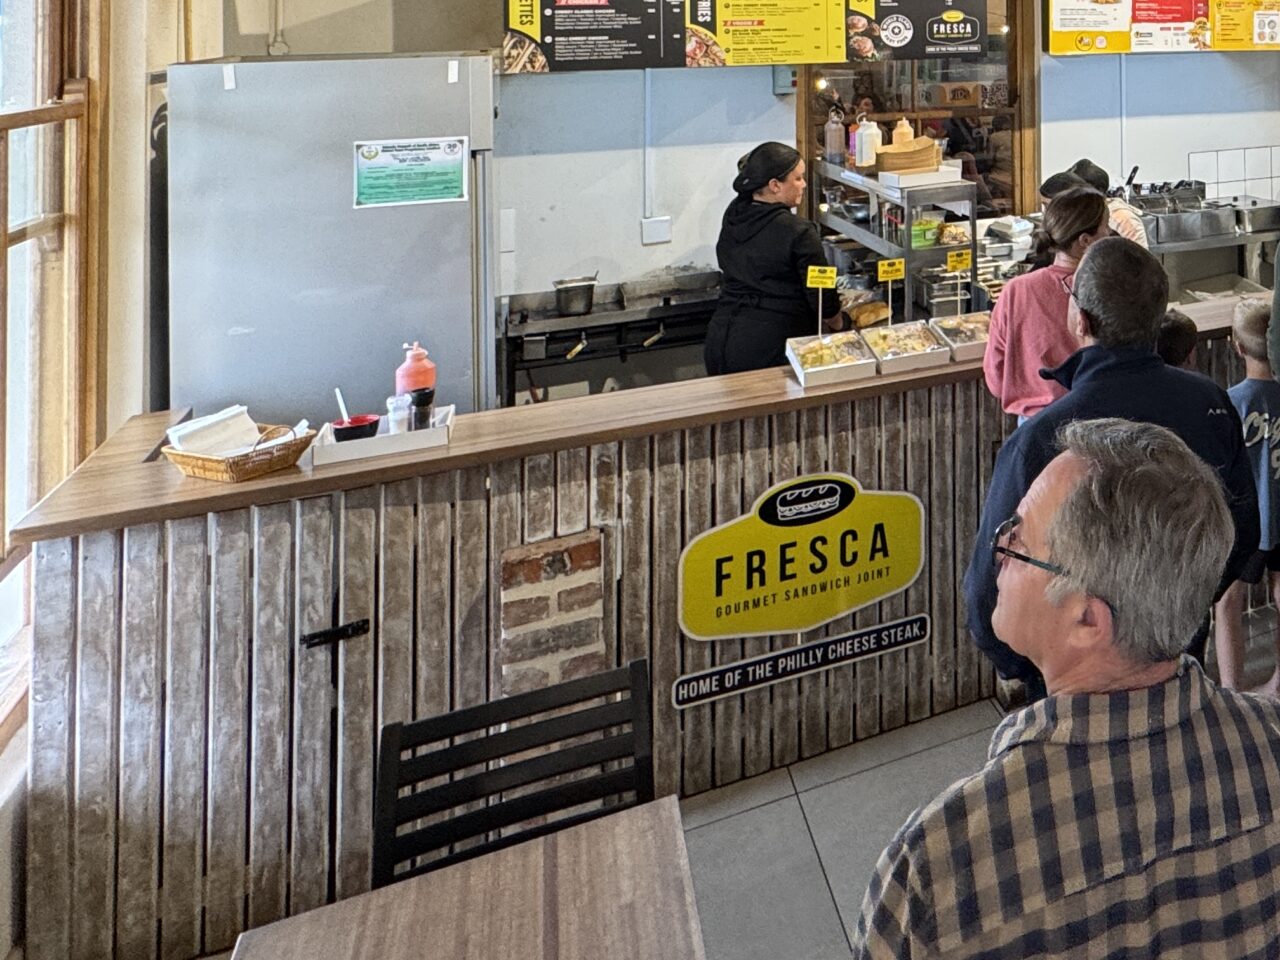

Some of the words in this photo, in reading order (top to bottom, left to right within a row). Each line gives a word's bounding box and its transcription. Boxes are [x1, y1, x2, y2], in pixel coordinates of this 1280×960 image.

[933, 23, 972, 34] FRESCA
[714, 522, 890, 597] FRESCA
[715, 593, 778, 619] GOURMET
[784, 576, 851, 603] SANDWICH
[856, 565, 892, 585] JOINT
[677, 675, 720, 701] HOME
[723, 669, 744, 688] OF
[747, 660, 774, 682] THE
[777, 647, 824, 675] PHILLY
[827, 635, 879, 663] CHEESE
